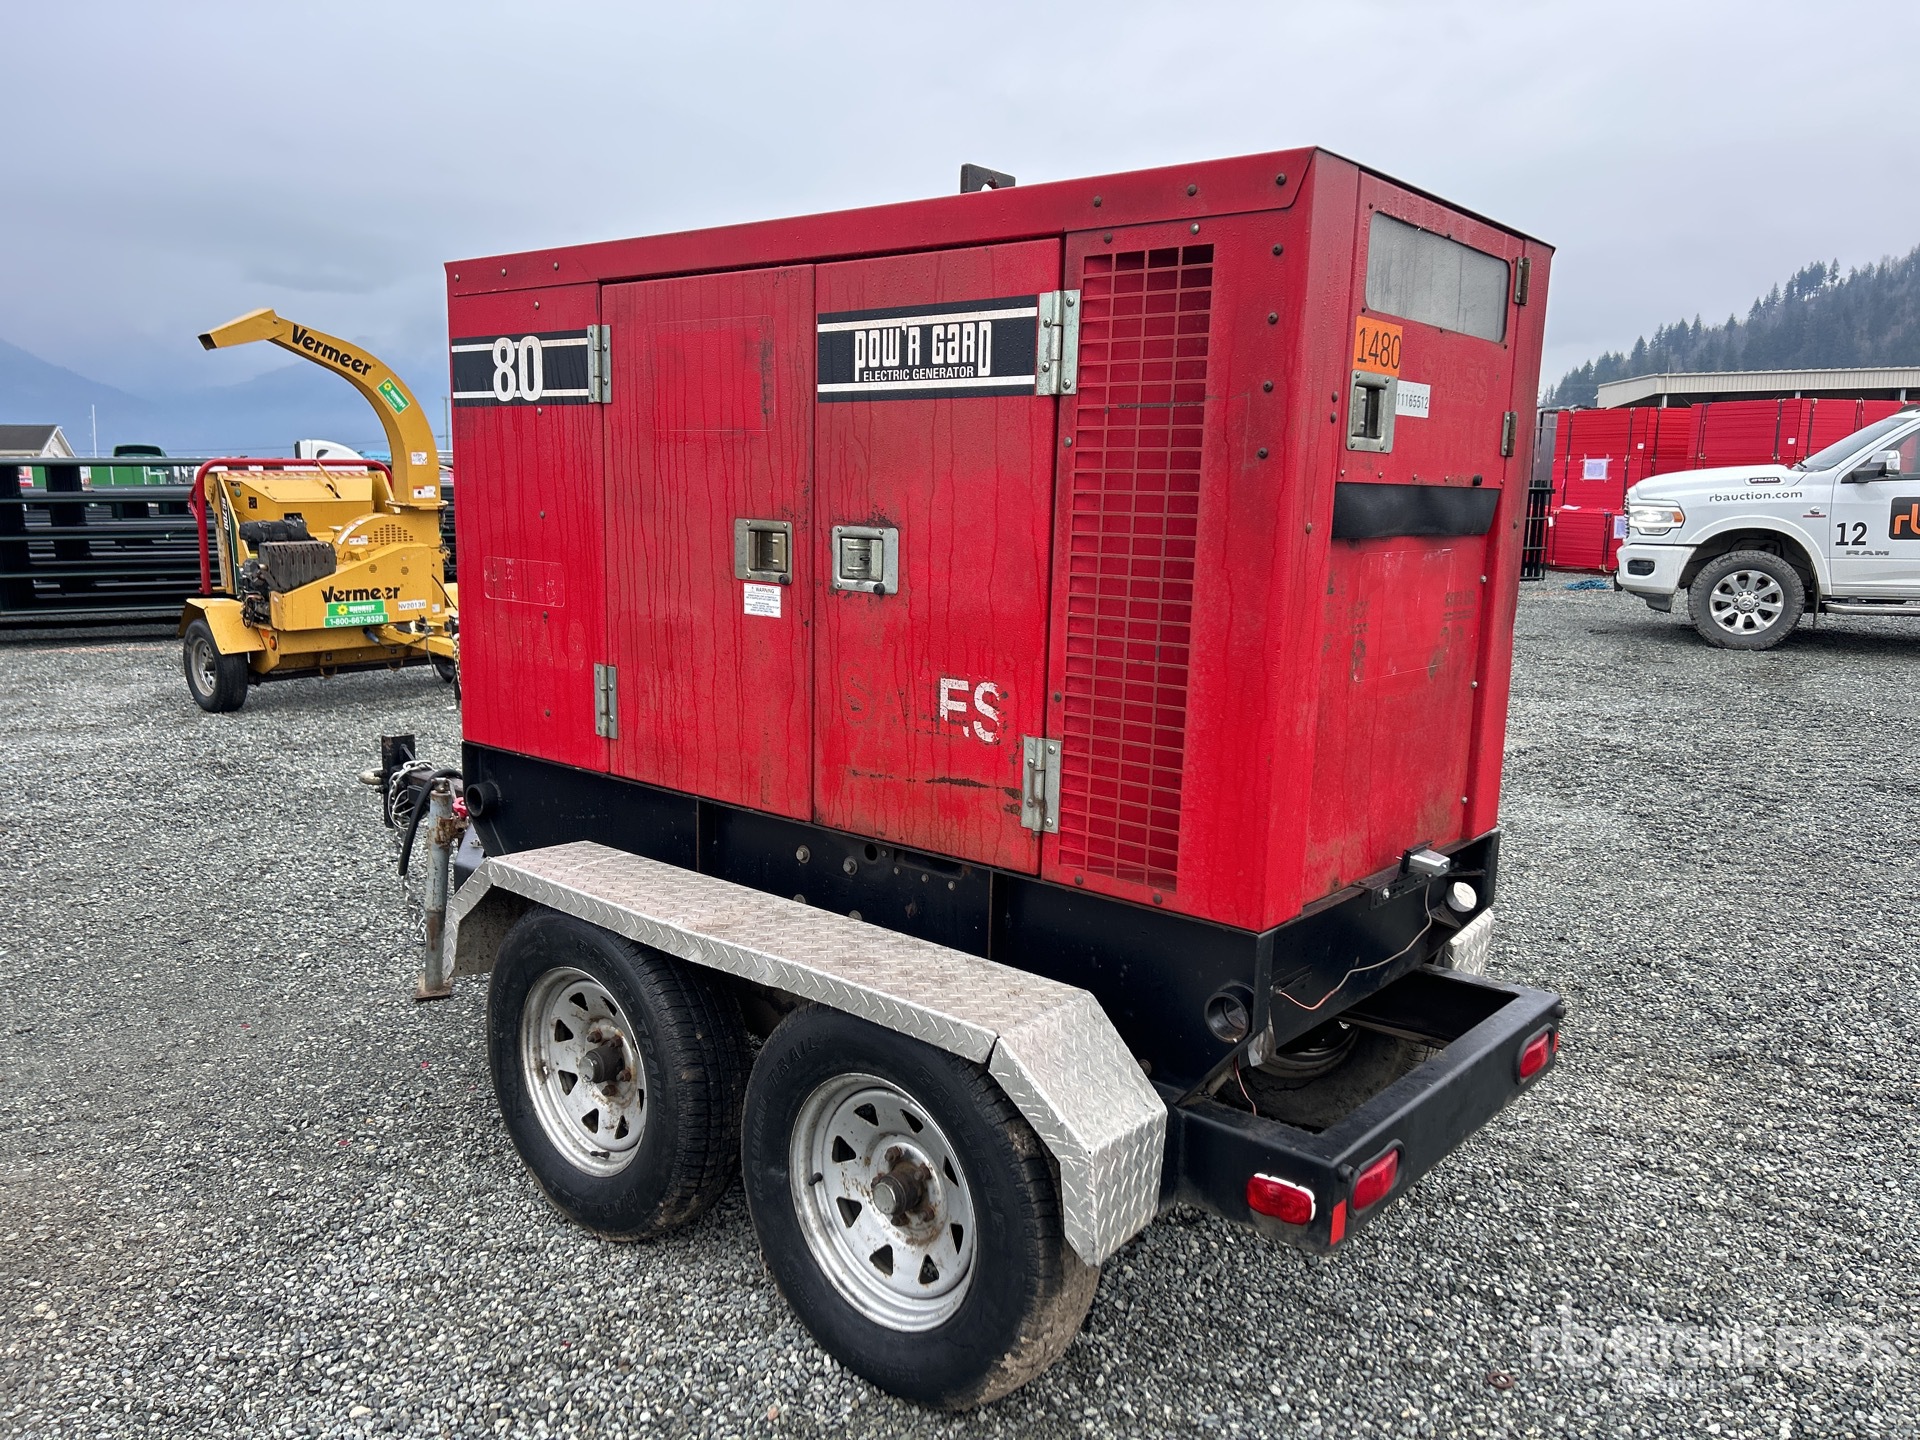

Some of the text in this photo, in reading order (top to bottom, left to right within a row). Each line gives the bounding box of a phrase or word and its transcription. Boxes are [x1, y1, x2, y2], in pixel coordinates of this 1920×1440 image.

[292, 324, 372, 376] Vermeer
[1357, 326, 1402, 370] 1480
[492, 335, 544, 402] 80
[863, 366, 974, 382] ELECTRIC GENERATOR
[1397, 391, 1429, 410] 11165512
[1708, 490, 1803, 502] rbauction.com
[1835, 521, 1868, 546] 12
[321, 586, 401, 603] Vermeer
